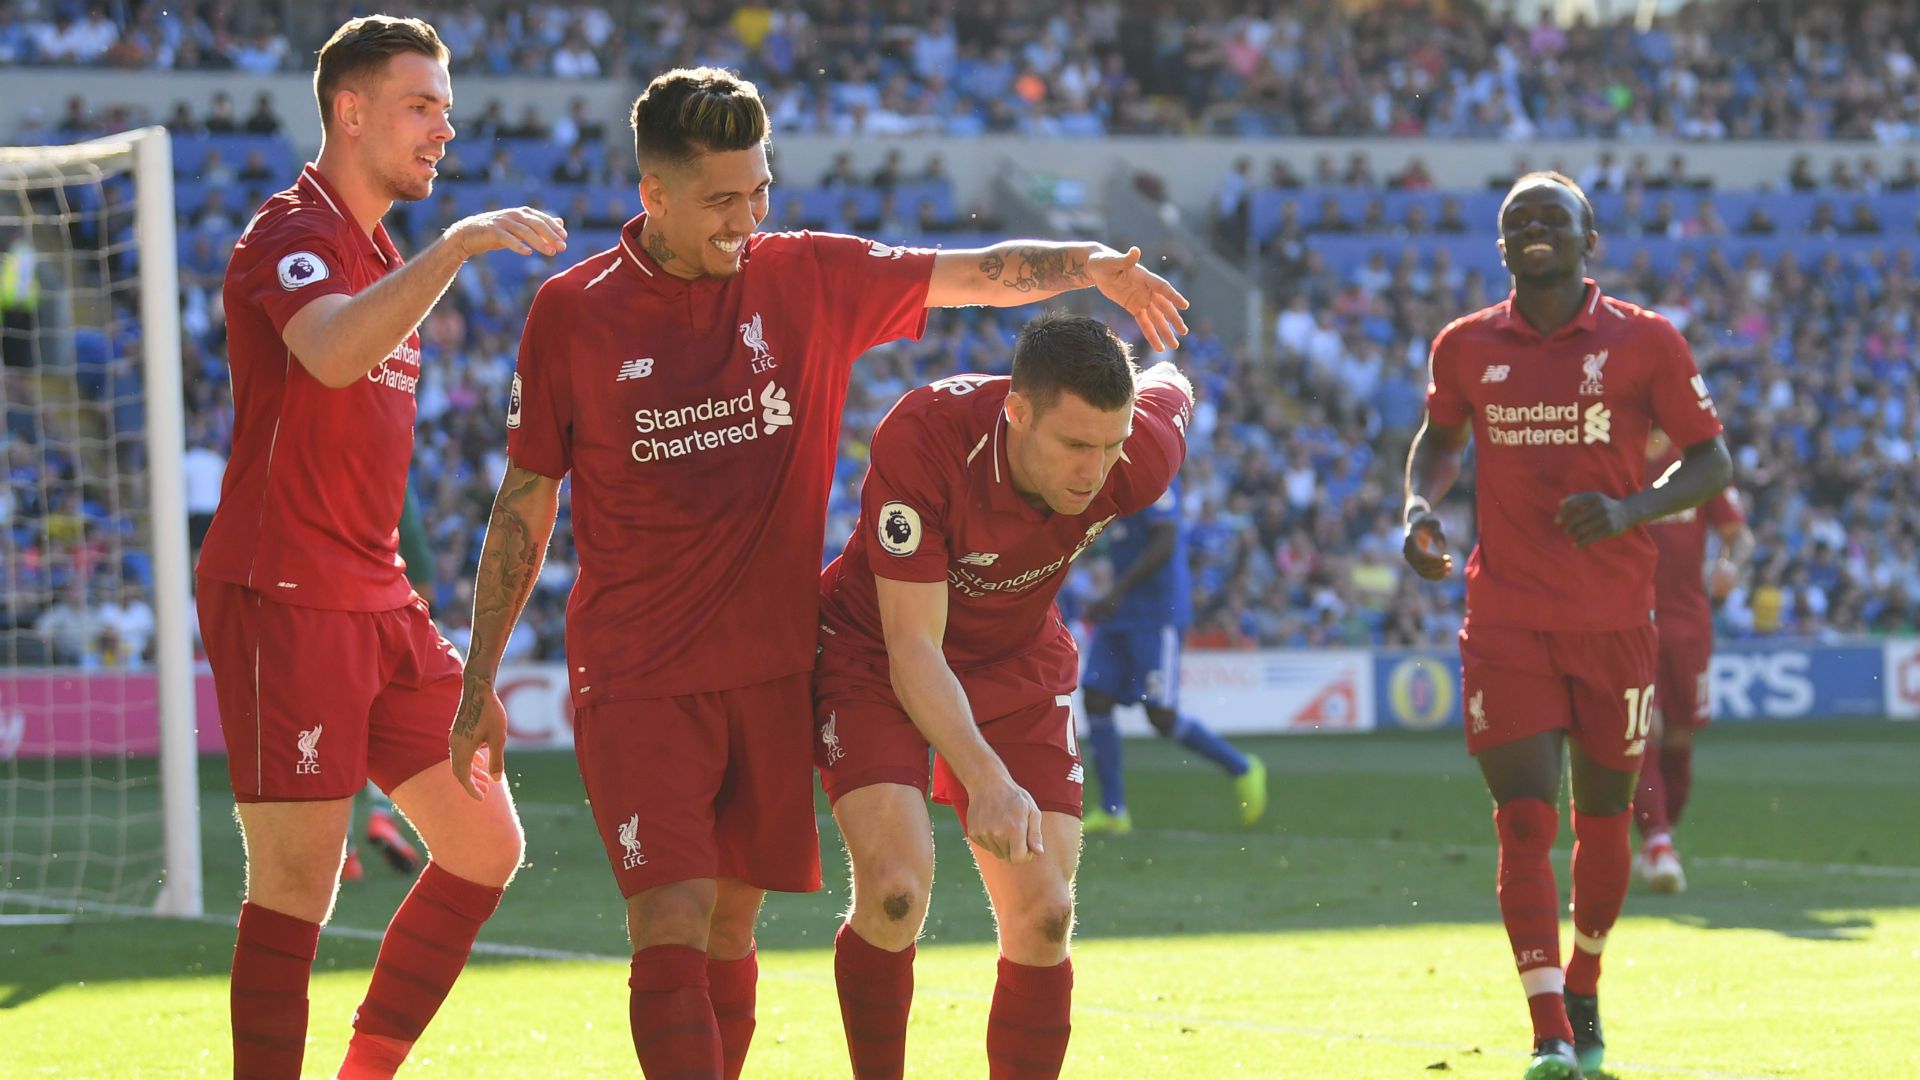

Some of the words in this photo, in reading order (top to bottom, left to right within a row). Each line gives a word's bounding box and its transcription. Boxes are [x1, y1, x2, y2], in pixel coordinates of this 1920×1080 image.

[634, 388, 754, 433] Standard
[1485, 401, 1579, 424] Standard
[631, 416, 758, 462] Chartered
[1055, 694, 1077, 757] 7
[1623, 684, 1655, 740] 10
